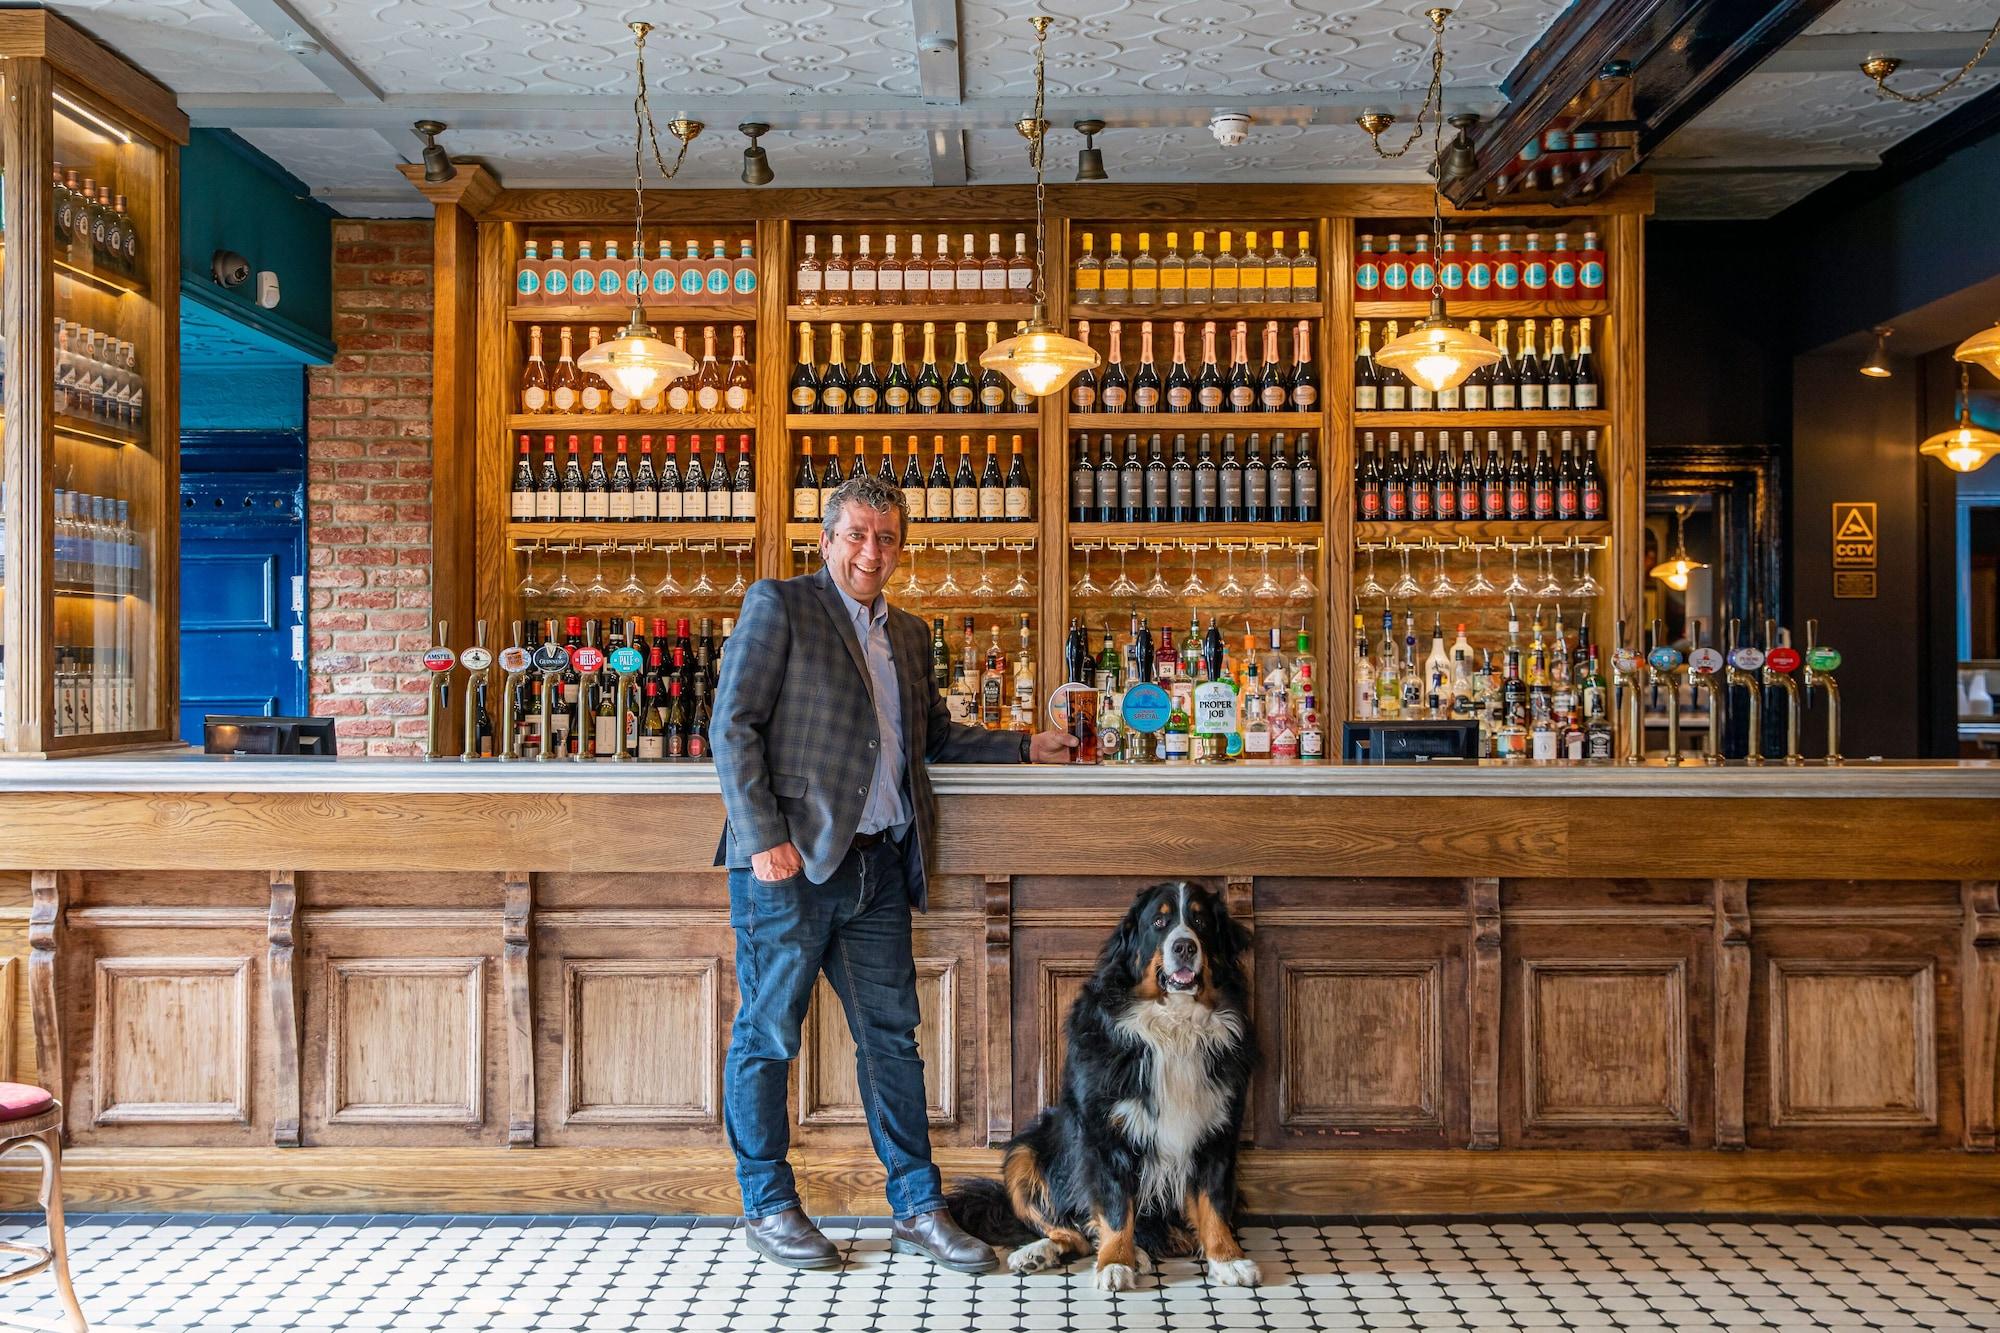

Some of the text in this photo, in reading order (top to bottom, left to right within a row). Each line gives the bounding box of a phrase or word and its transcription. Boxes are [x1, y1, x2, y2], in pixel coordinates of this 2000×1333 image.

[1836, 544, 1873, 556] CCTV
[580, 653, 596, 665] HELLS
[620, 655, 633, 666] PALE
[1200, 701, 1232, 709] PROPER
[1209, 710, 1224, 719] JOB
